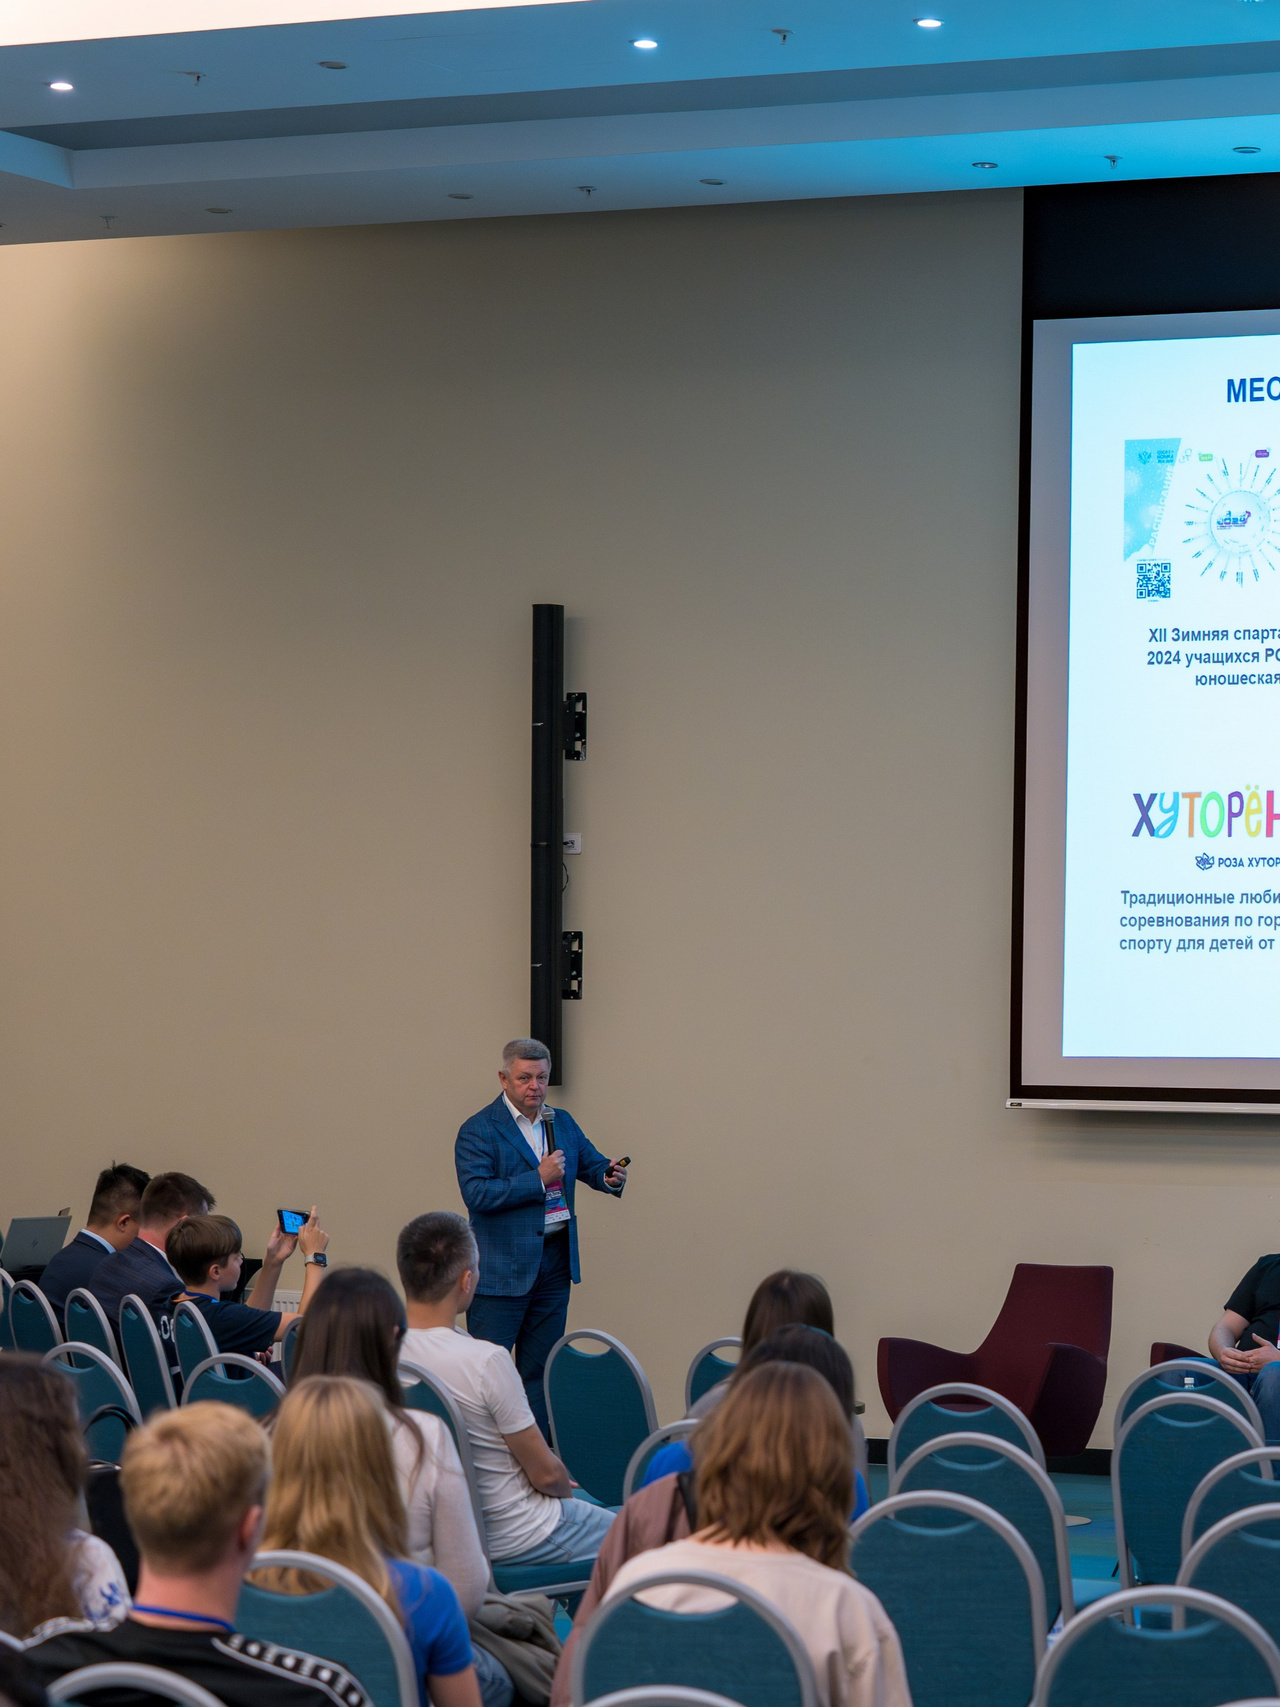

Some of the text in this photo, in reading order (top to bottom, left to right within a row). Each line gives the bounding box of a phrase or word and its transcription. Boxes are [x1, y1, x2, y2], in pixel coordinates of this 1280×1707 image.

[1171, 628, 1229, 642] Зимняя
[1147, 650, 1181, 665] 2024
[1185, 652, 1260, 668] учащихся
[1218, 857, 1280, 868] РОЗА ХУТОР
[1120, 890, 1235, 908] Традиционные
[1120, 916, 1229, 931] соревнования
[1235, 916, 1253, 927] по
[1120, 939, 1172, 954] спорту
[1176, 939, 1205, 952] для
[1209, 936, 1253, 952] детей
[1258, 938, 1275, 950] от
